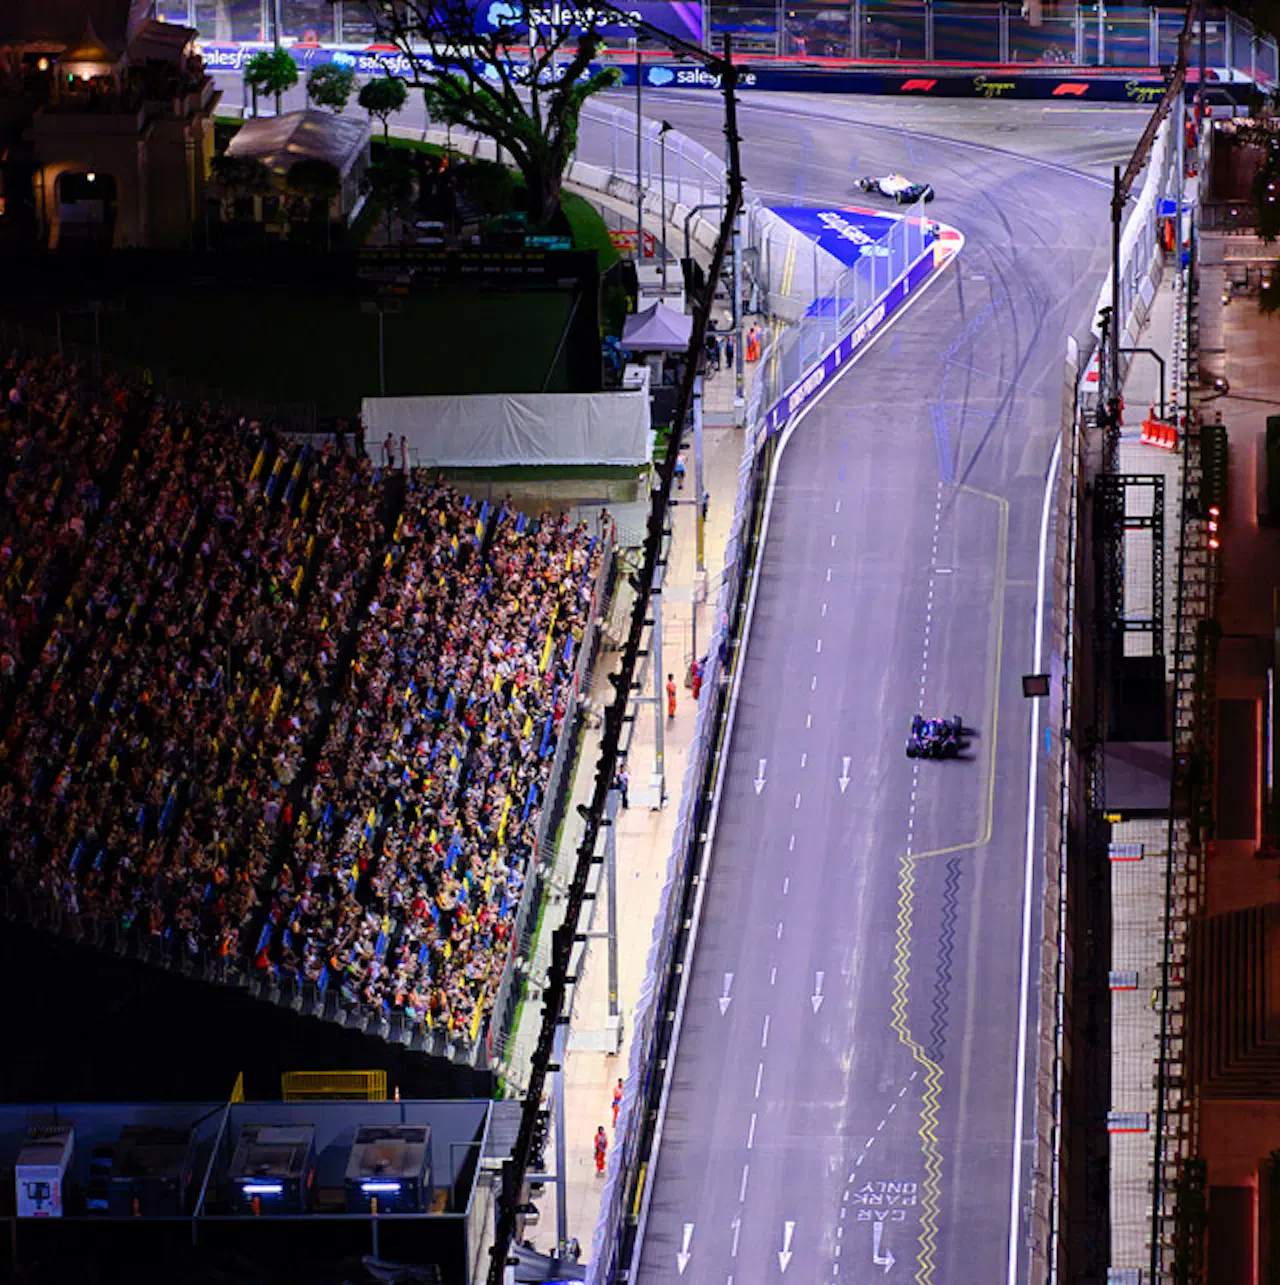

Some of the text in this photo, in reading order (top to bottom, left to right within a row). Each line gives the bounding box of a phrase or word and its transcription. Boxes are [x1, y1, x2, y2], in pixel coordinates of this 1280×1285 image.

[859, 1182, 918, 1193] ONLY
[852, 1194, 917, 1206] PARK
[856, 1209, 907, 1222] CAR
